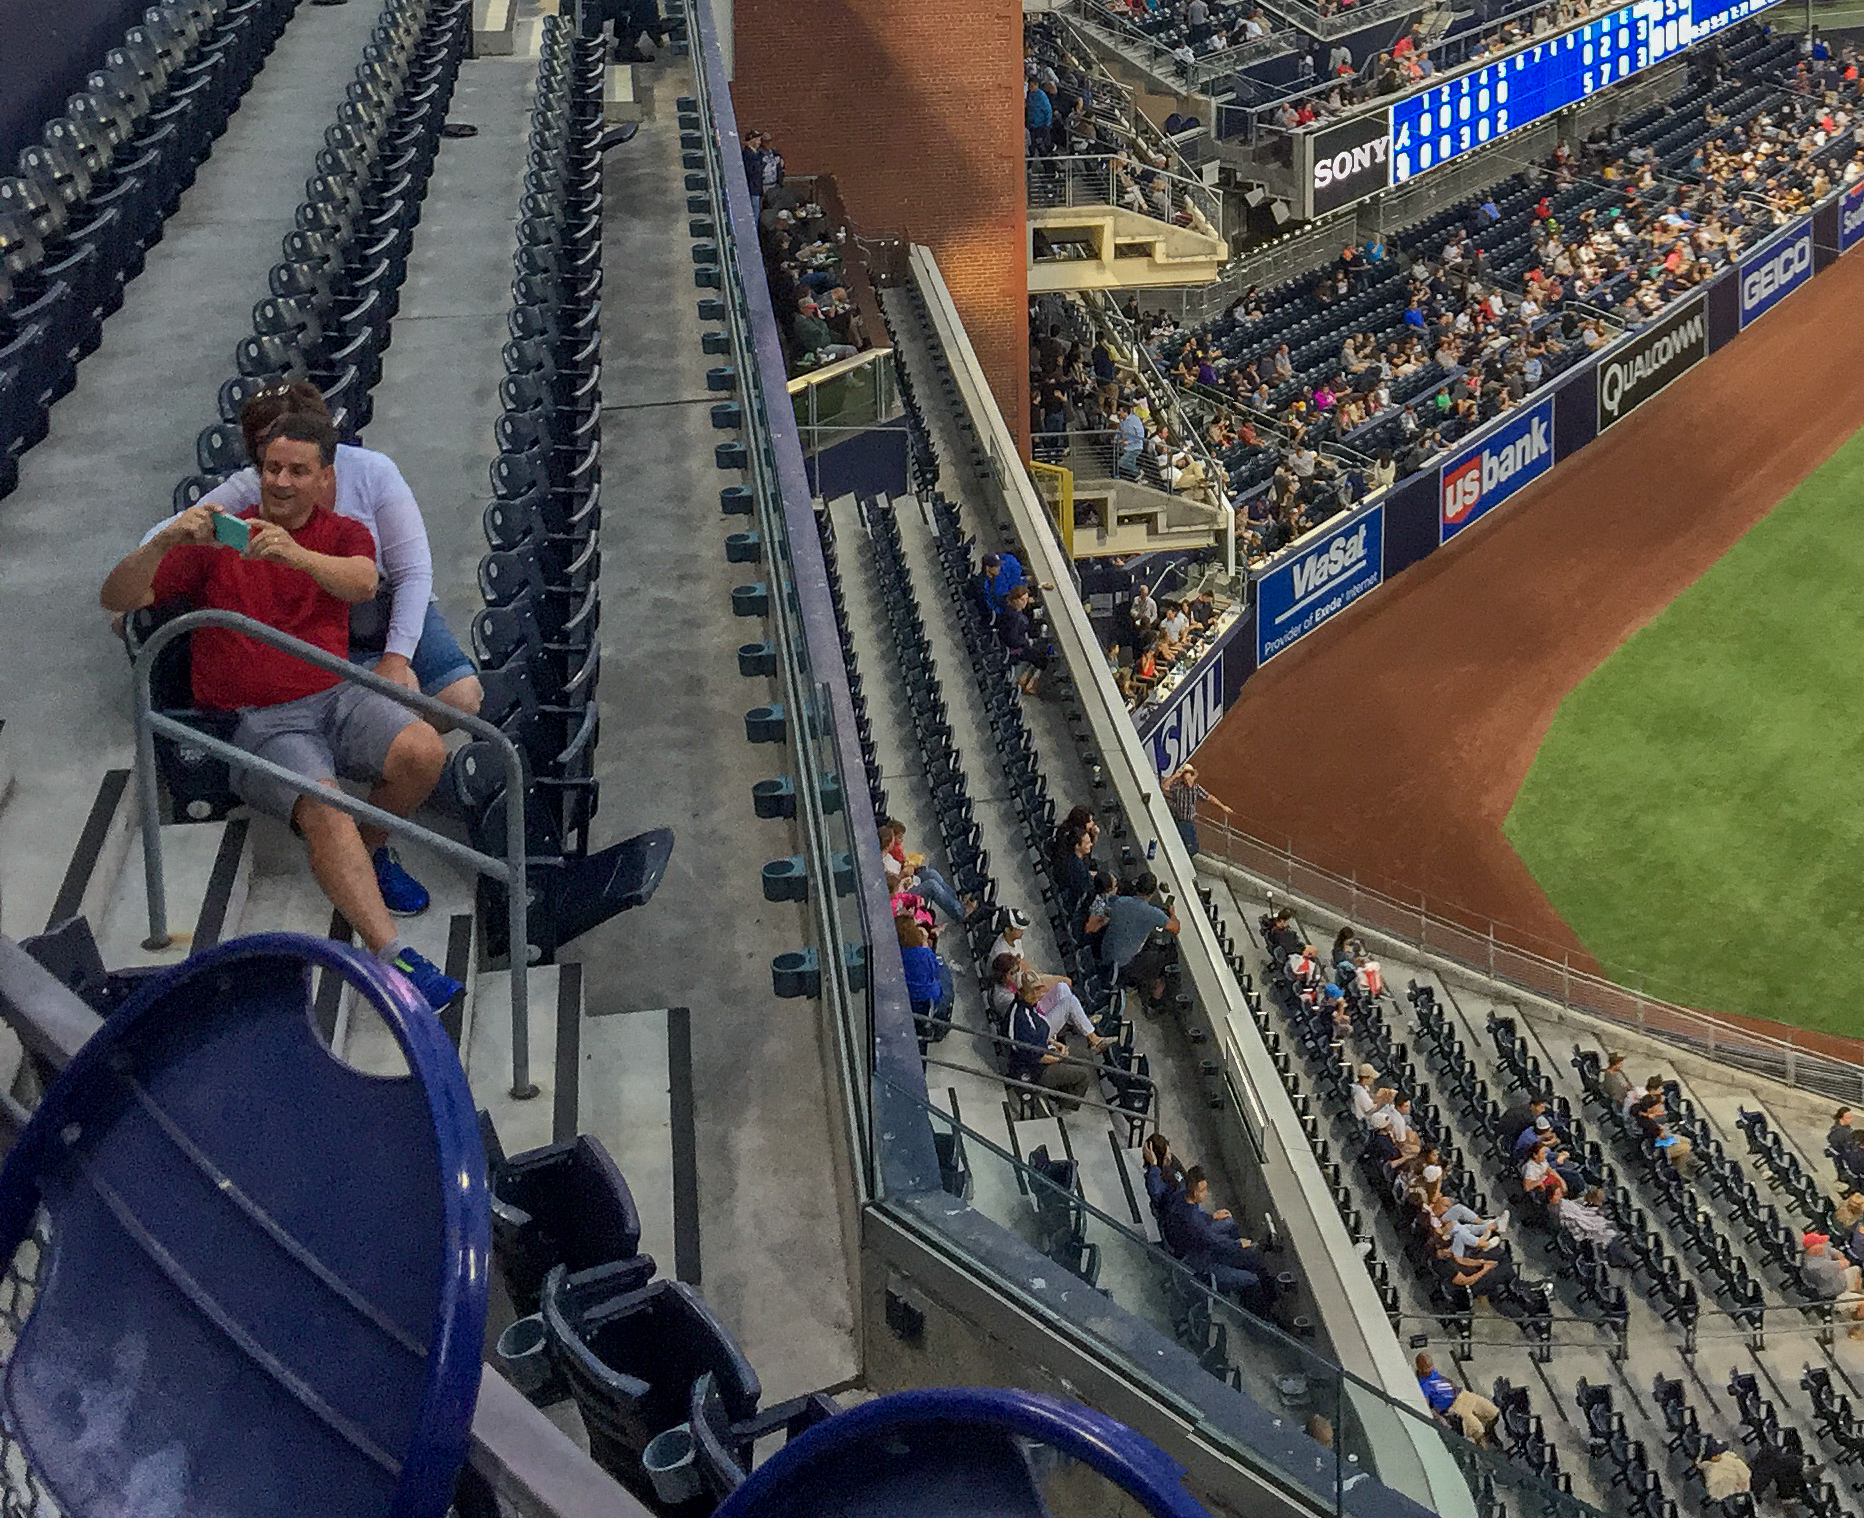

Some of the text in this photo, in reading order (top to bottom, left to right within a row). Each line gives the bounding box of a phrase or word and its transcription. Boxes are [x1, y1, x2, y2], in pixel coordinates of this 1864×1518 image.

[1600, 35, 1611, 58] 2
[1583, 72, 1593, 94] 5
[1600, 63, 1611, 85] 7
[1313, 135, 1391, 188] SONY
[1743, 235, 1812, 311] GEICO
[1264, 620, 1303, 656] Provider
[1303, 611, 1314, 629] of
